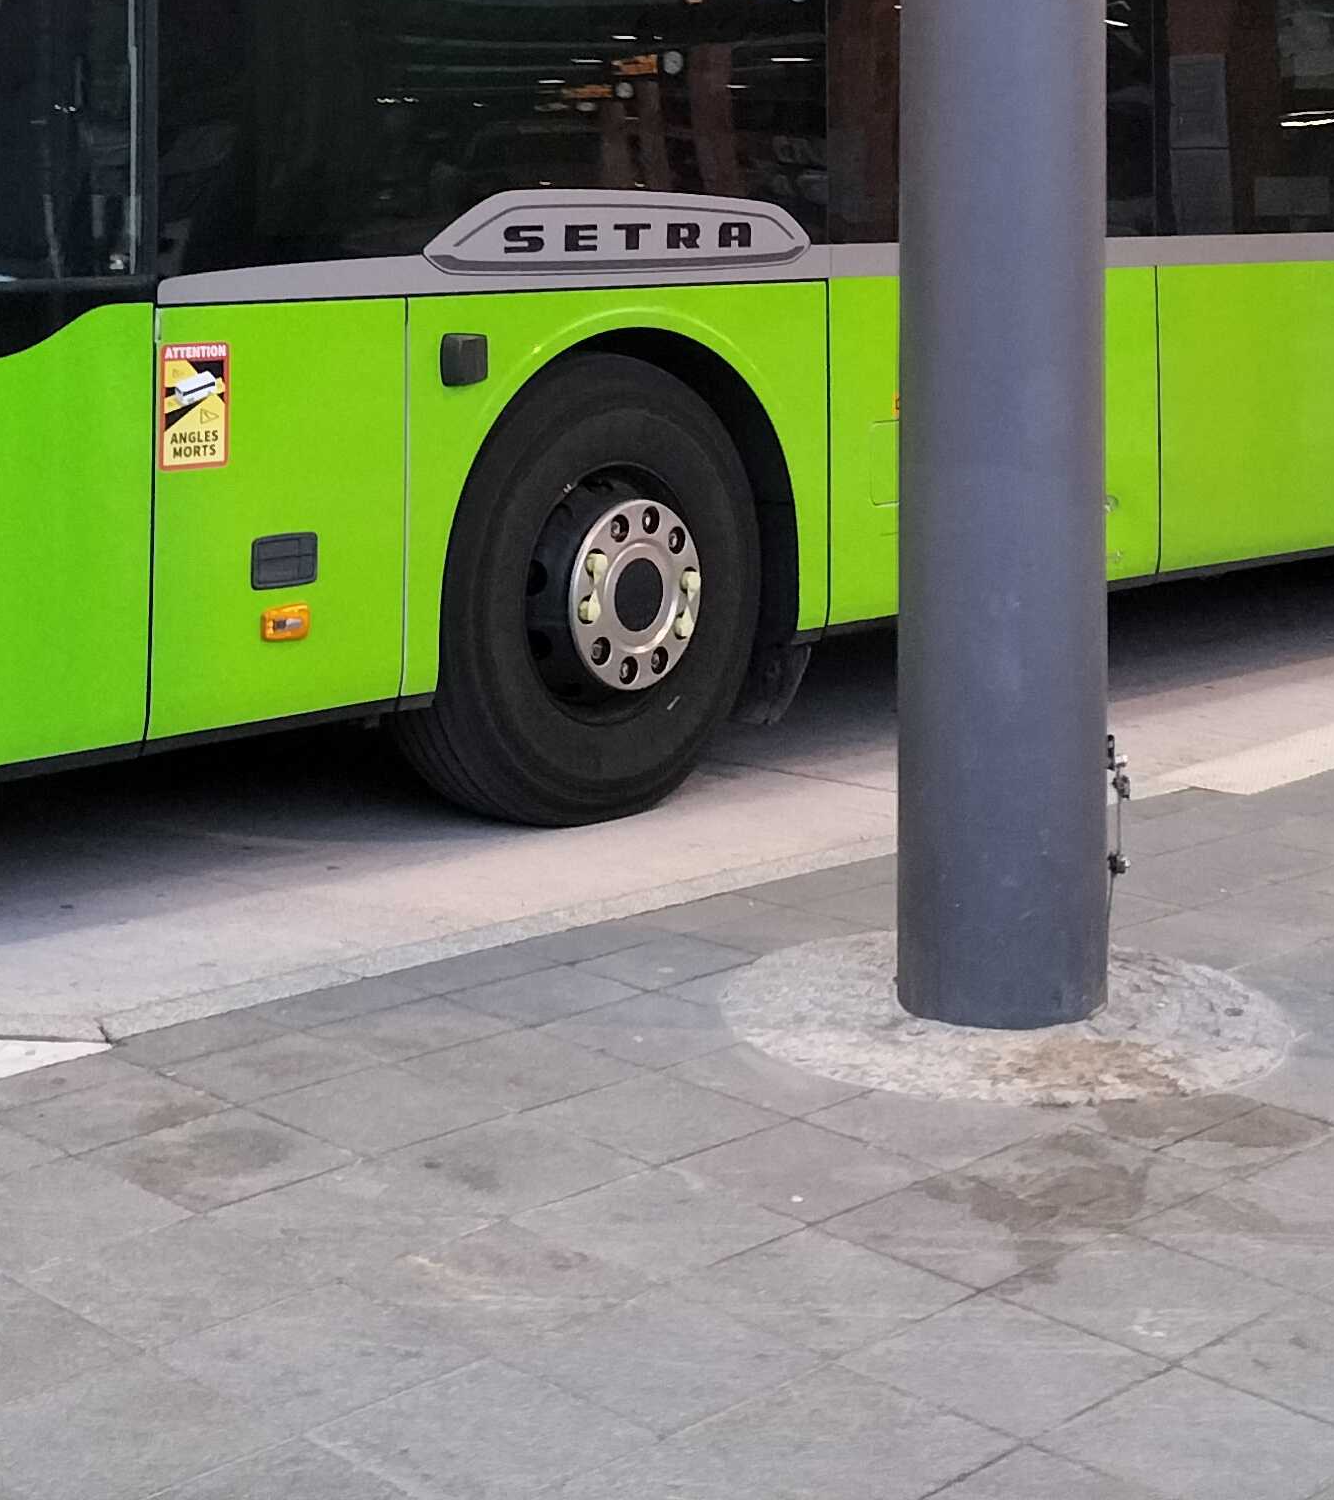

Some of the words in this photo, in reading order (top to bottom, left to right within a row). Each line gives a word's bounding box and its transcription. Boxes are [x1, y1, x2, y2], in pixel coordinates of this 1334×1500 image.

[503, 222, 752, 254] SETRA
[164, 345, 227, 359] ATTENTION
[170, 430, 219, 445] ANGLES
[172, 444, 217, 459] MORTS
